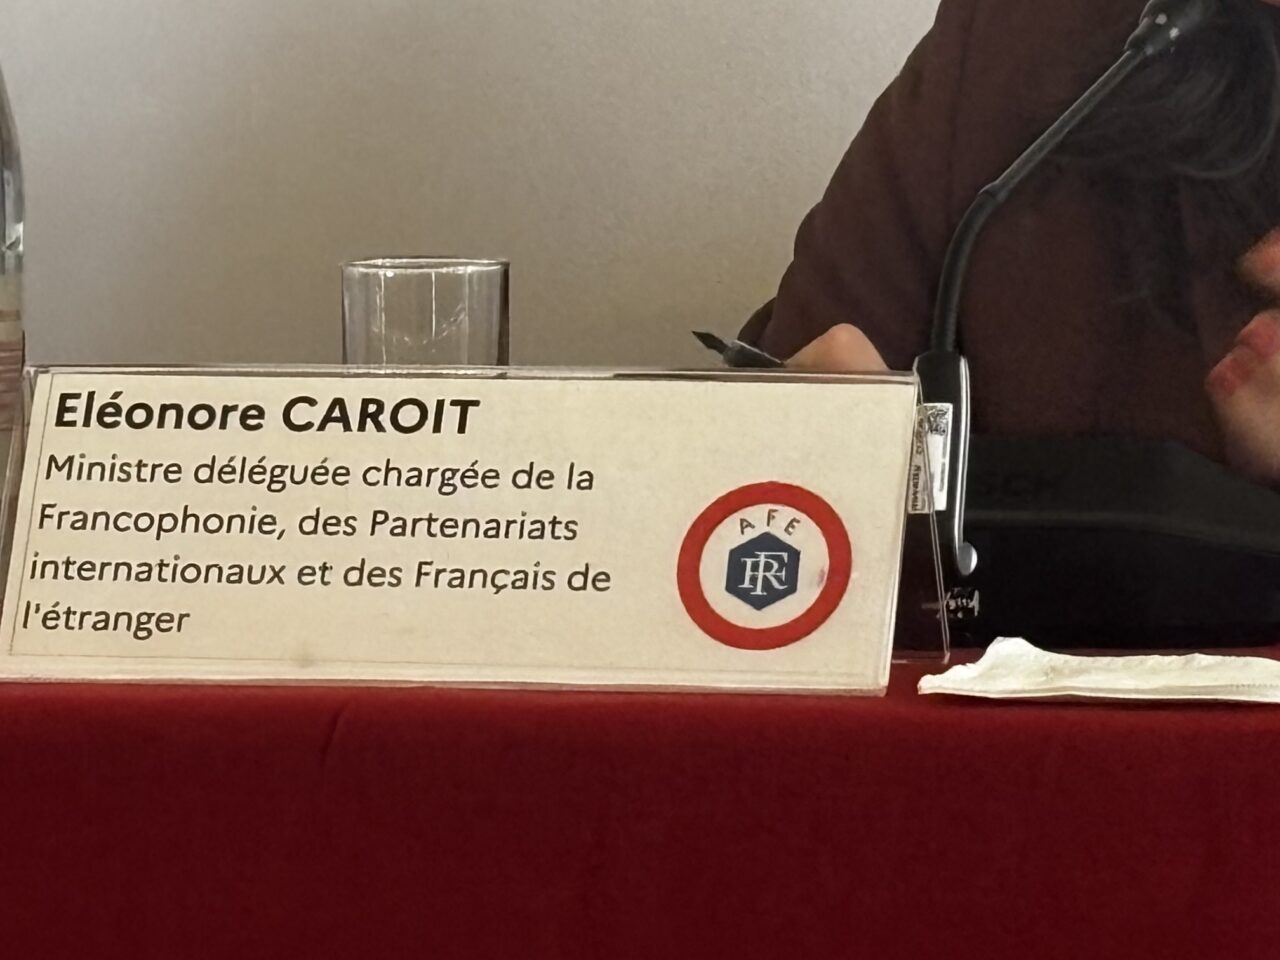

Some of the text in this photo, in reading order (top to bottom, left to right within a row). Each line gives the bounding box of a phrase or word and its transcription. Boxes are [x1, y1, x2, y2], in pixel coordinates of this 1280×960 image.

[53, 389, 482, 436] Eléonore CAROIT
[44, 452, 596, 498] Ministre déléguée chargée de la
[37, 502, 580, 542] Francophonie, des Partenariats
[28, 550, 612, 596] internationaux et des Français de
[21, 599, 192, 642] l'étranger
